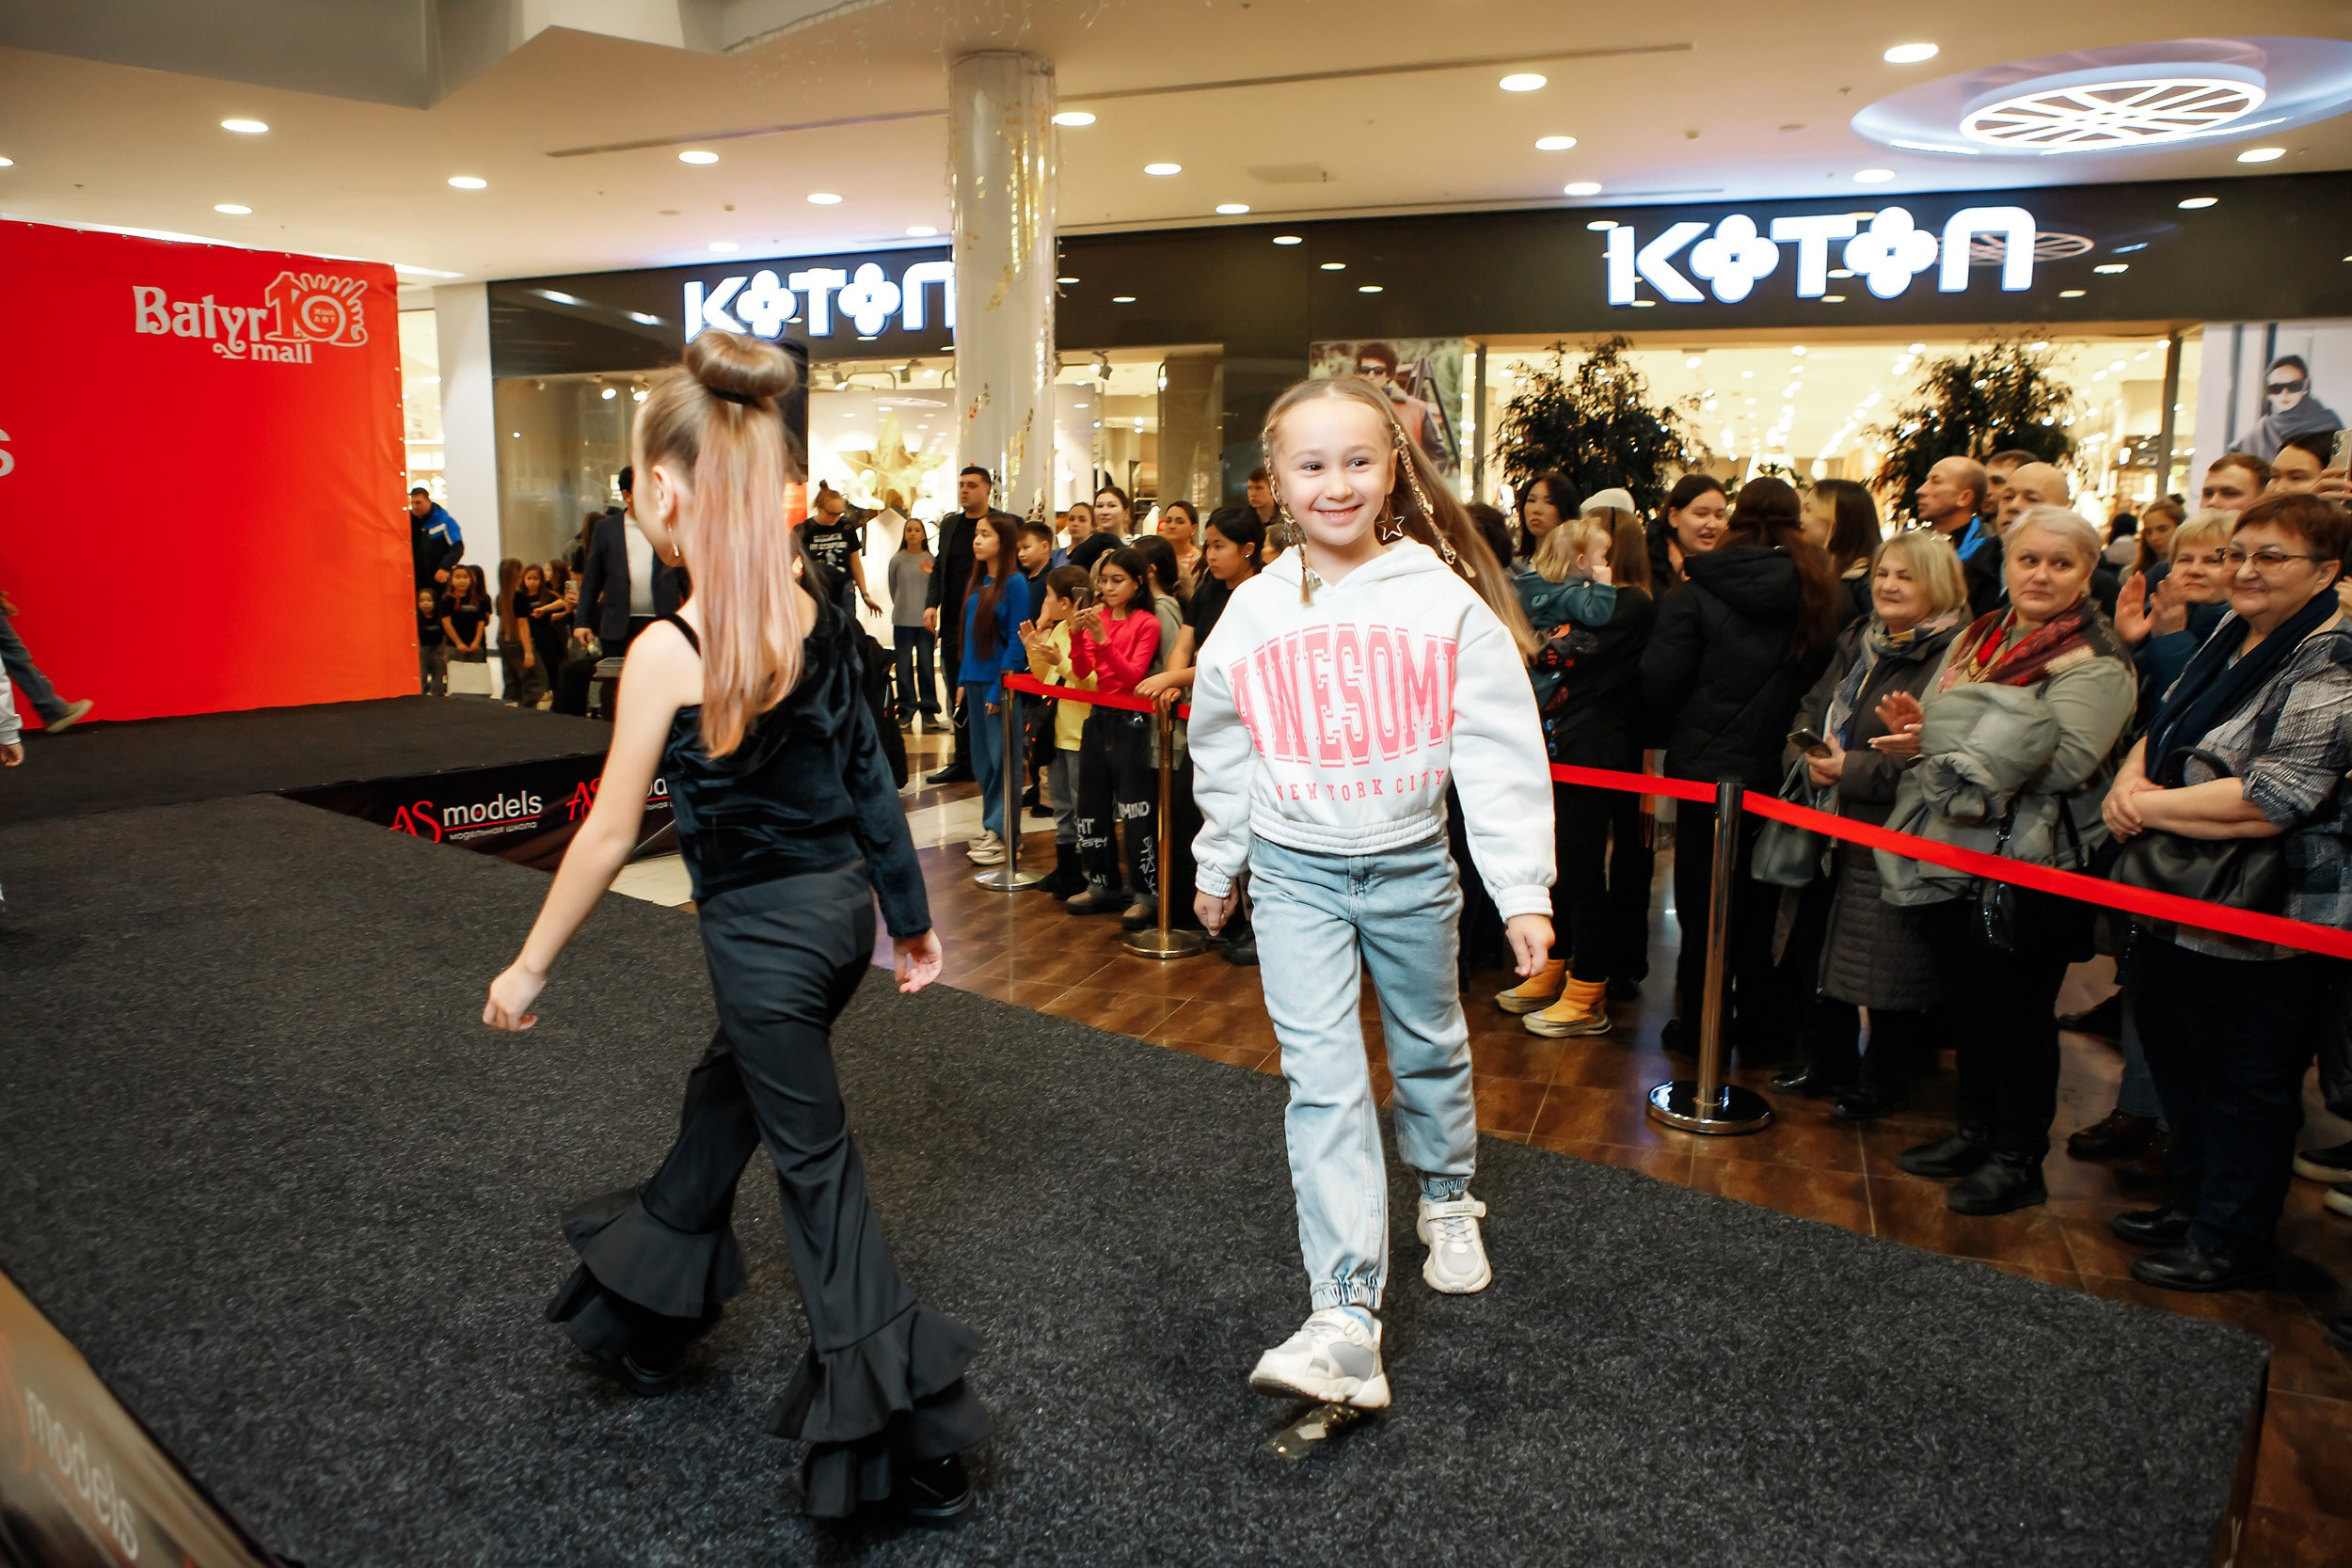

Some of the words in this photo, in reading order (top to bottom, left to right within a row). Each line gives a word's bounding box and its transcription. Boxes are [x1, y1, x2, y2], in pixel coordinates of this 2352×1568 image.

[132, 285, 268, 359] Batyr
[250, 342, 312, 364] mall
[1276, 783, 1317, 801] NEW
[1327, 779, 1383, 801] YORK
[1396, 769, 1445, 794] CITY
[443, 791, 543, 826] models
